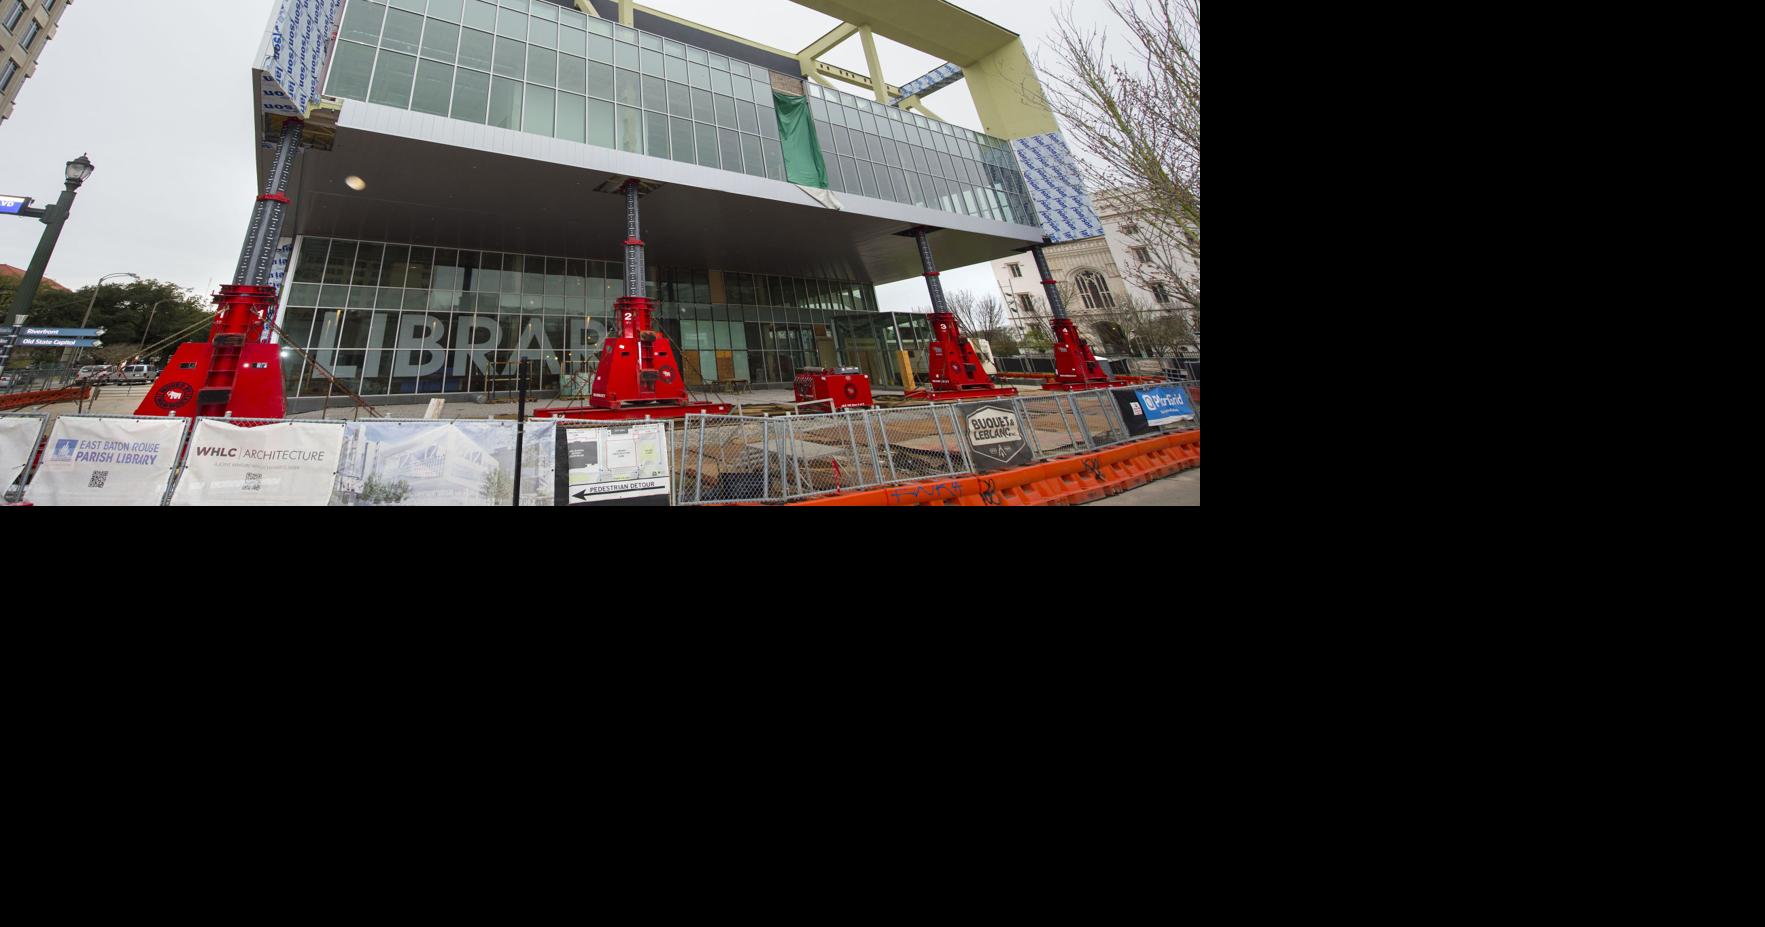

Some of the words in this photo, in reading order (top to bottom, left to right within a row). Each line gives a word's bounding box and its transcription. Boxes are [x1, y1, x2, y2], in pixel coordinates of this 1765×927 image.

[624, 312, 632, 321] 2
[311, 311, 609, 379] LIBRAR
[971, 416, 1009, 430] BUQUET
[973, 428, 1010, 441] LEBLANC
[79, 440, 102, 450] EAST
[103, 441, 130, 451] BATON
[131, 442, 160, 453] ROUGE
[75, 452, 113, 463] PARISH
[196, 446, 237, 457] WHLC
[243, 448, 326, 461] ARCHITECTURE
[589, 484, 629, 493] PEDESTRIAN
[630, 481, 655, 489] DETOUR
